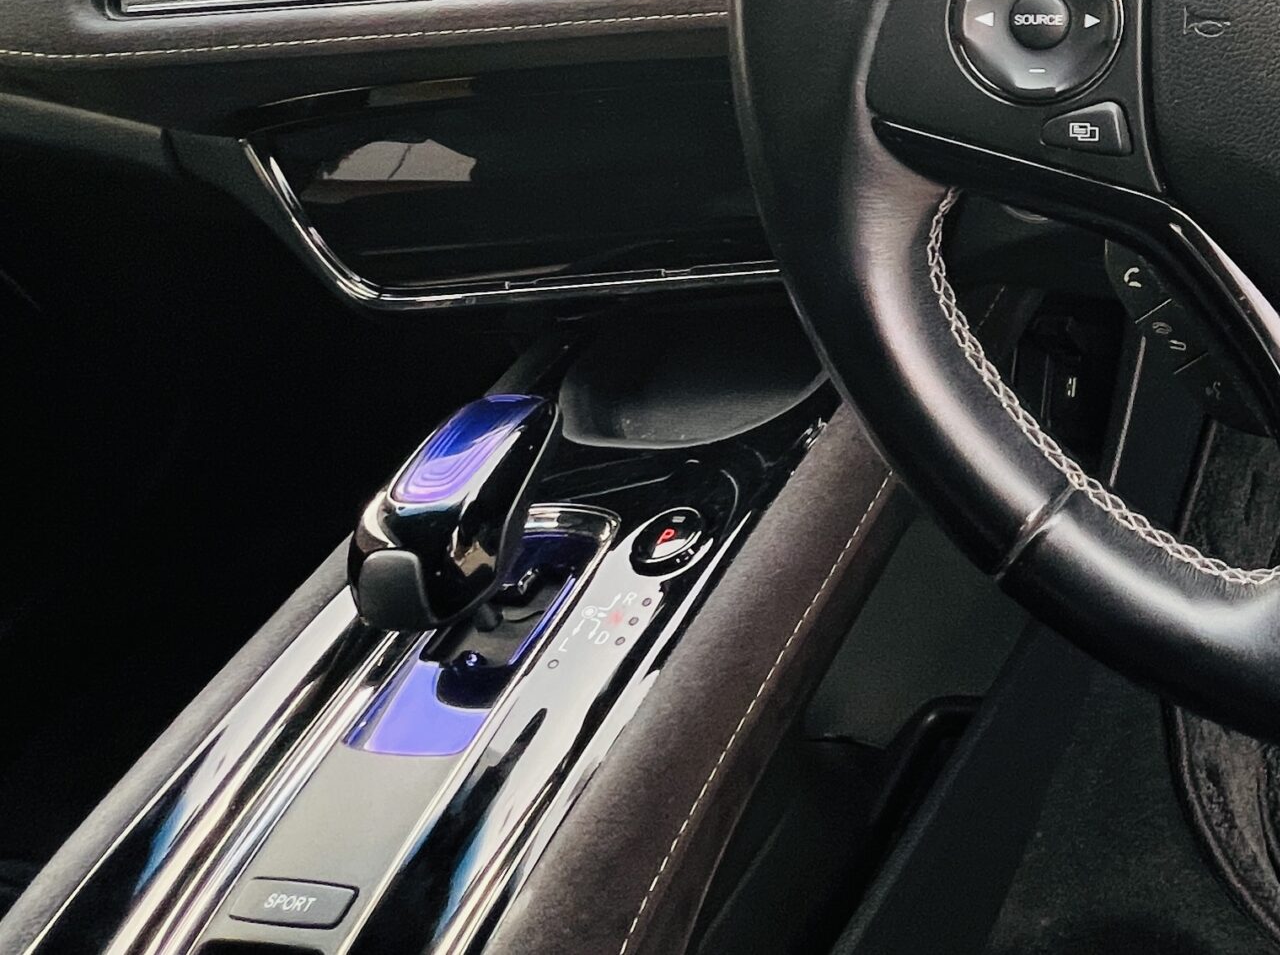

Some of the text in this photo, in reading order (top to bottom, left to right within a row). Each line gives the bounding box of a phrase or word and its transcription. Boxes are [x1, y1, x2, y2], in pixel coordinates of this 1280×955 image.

[1013, 14, 1064, 26] SOURCE
[656, 527, 677, 545] P
[622, 592, 638, 606] R
[558, 637, 569, 652] L
[594, 630, 610, 645] D
[263, 892, 318, 913] SPORT
